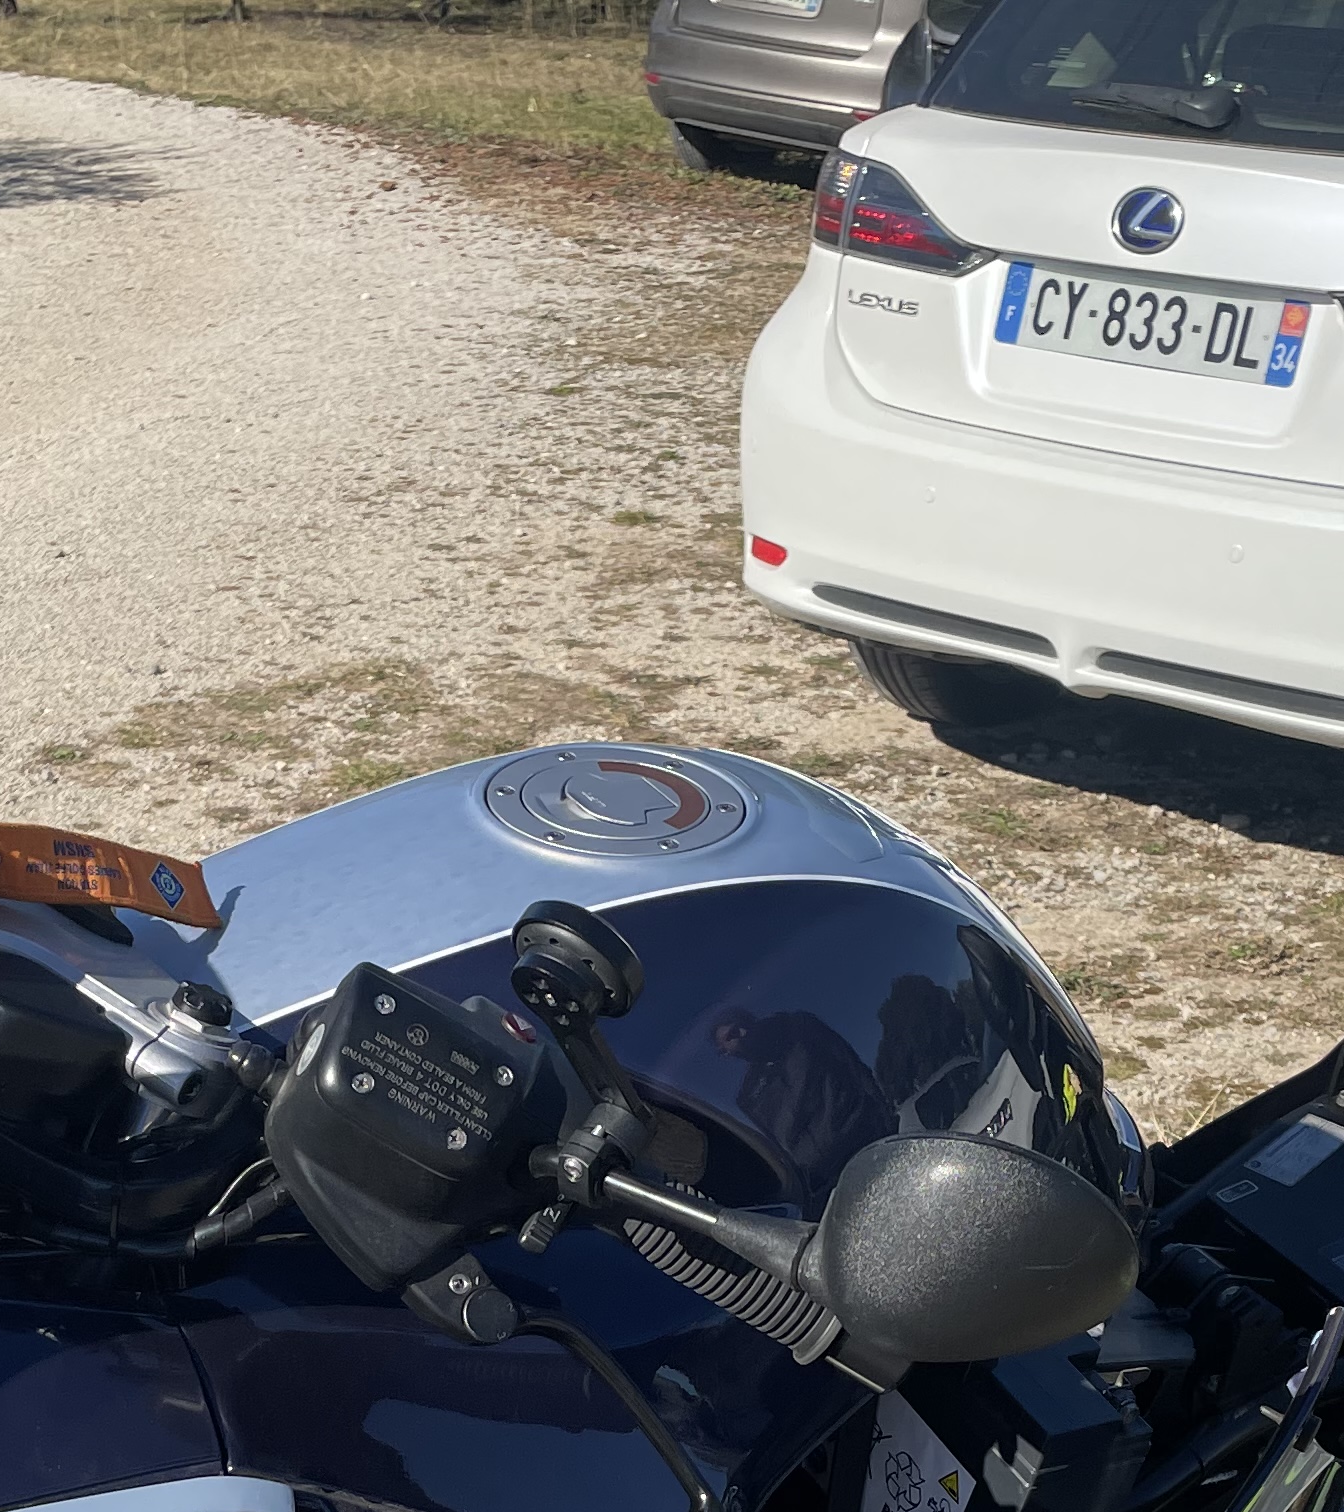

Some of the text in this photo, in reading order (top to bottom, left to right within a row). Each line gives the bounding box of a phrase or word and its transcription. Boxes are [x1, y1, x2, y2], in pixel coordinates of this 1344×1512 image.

[846, 290, 919, 316] LEXUS
[1030, 278, 1260, 371] CY-833-DL
[1270, 341, 1297, 374] 34
[374, 1031, 422, 1065] CONTAINER
[360, 1039, 489, 1121] USE ONLY DOT 4 BRAKE FLUID
[421, 1061, 456, 1084] SEALED
[341, 1045, 492, 1142] CLEAN FILLER CAP BEFORE REMOVING
[387, 1087, 436, 1123] WARNING
[462, 1086, 487, 1105] FROM
